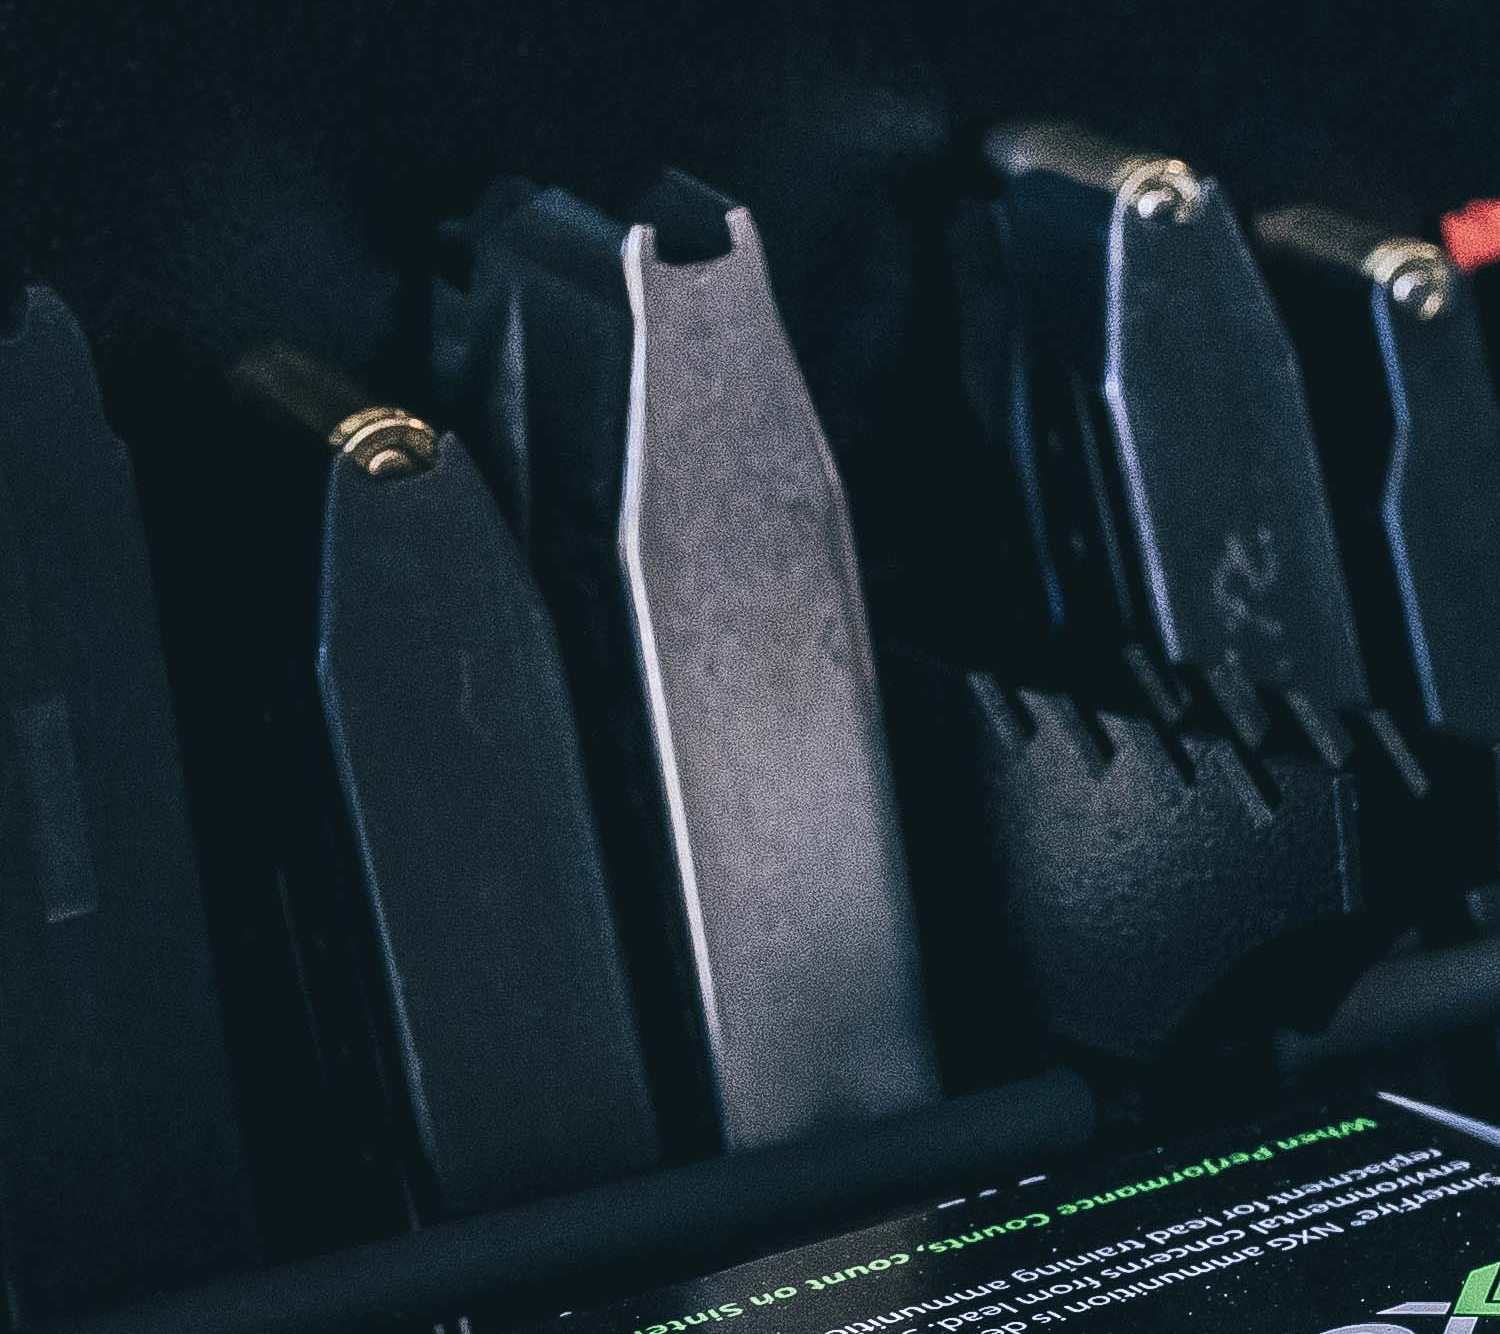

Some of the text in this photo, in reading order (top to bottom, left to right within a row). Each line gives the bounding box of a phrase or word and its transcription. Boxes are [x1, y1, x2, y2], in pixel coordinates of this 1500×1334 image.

[1277, 1117, 1377, 1151] When
[1056, 1146, 1274, 1216] Performance
[1249, 1159, 1471, 1235] environmental
[1222, 1200, 1270, 1223] for
[917, 1213, 1050, 1254] Counts,
[1146, 1216, 1222, 1246] lead
[1267, 1221, 1344, 1252] NXG
[1011, 1238, 1145, 1284] training
[1100, 1228, 1245, 1279] concerns
[805, 1253, 910, 1290] count
[1068, 1245, 1265, 1314] ammunition
[750, 1286, 797, 1307] on
[1015, 1276, 1102, 1306] from
[927, 1301, 1018, 1332] lead.
[1033, 1305, 1067, 1325] is
